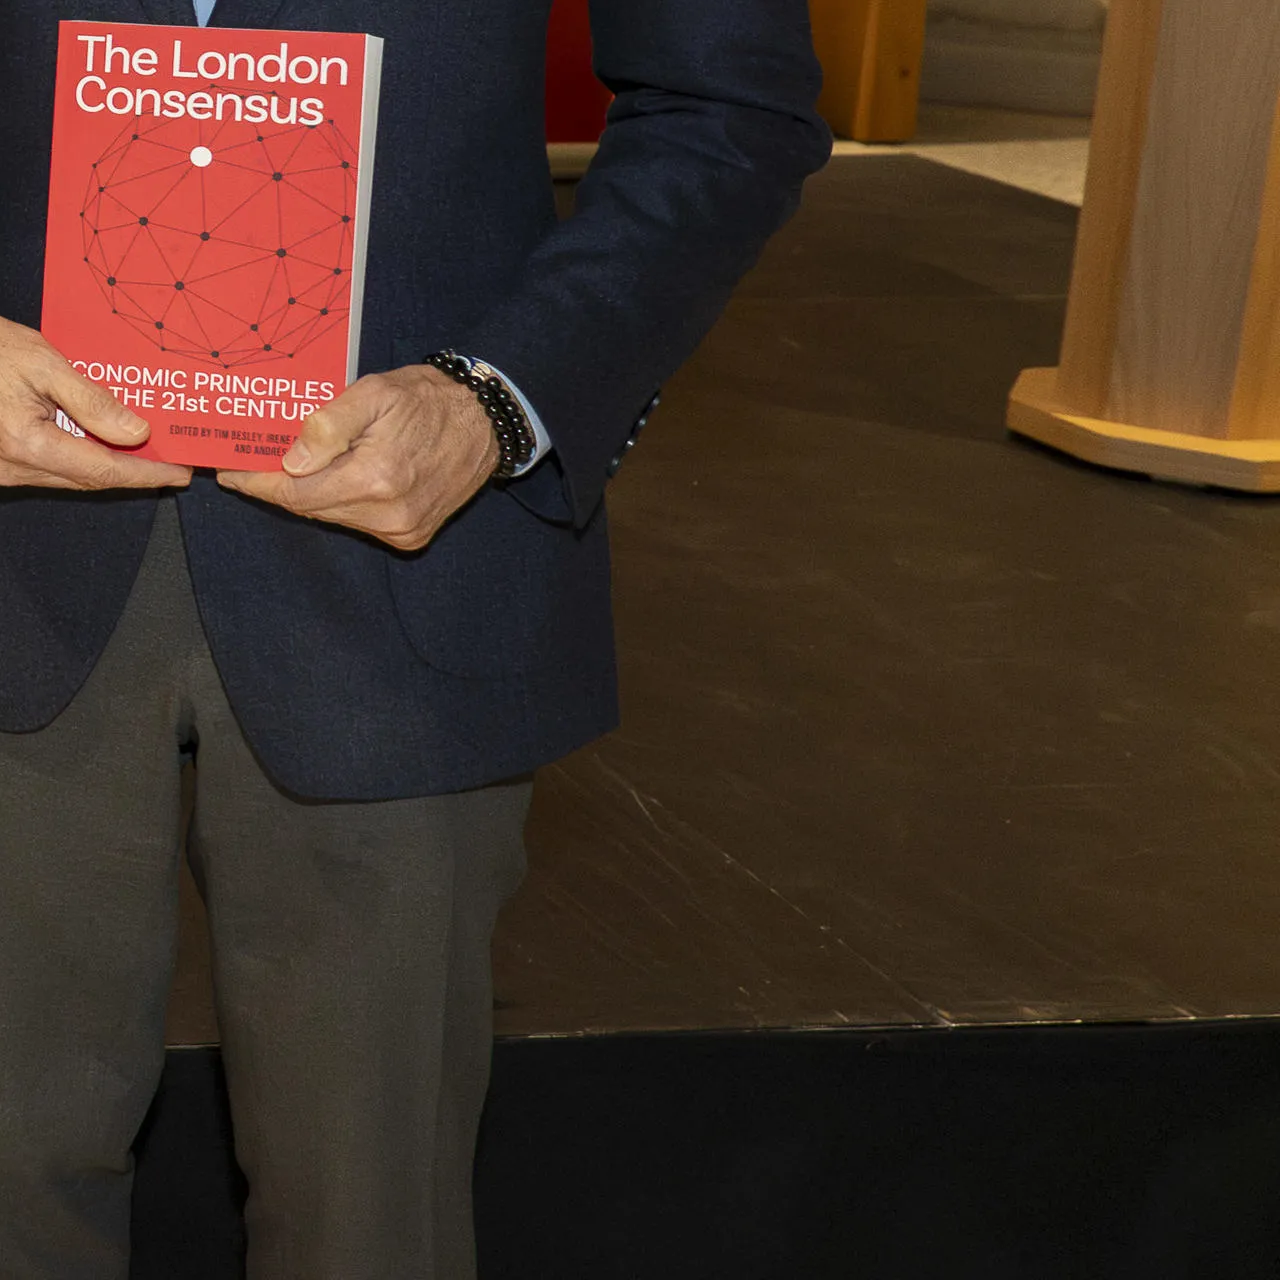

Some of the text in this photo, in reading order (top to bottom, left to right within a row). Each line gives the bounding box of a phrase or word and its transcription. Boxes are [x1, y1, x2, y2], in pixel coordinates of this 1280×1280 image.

[77, 34, 348, 86] The London
[75, 75, 324, 126] Consensus
[68, 359, 335, 401] CONOMIC PRINCIPLES
[108, 386, 321, 422] THE 21st CENTUR
[169, 425, 199, 437] EDITED
[200, 427, 211, 438] BY
[214, 428, 229, 440] TIM
[266, 433, 291, 445] IRENE
[234, 443, 251, 455] AND
